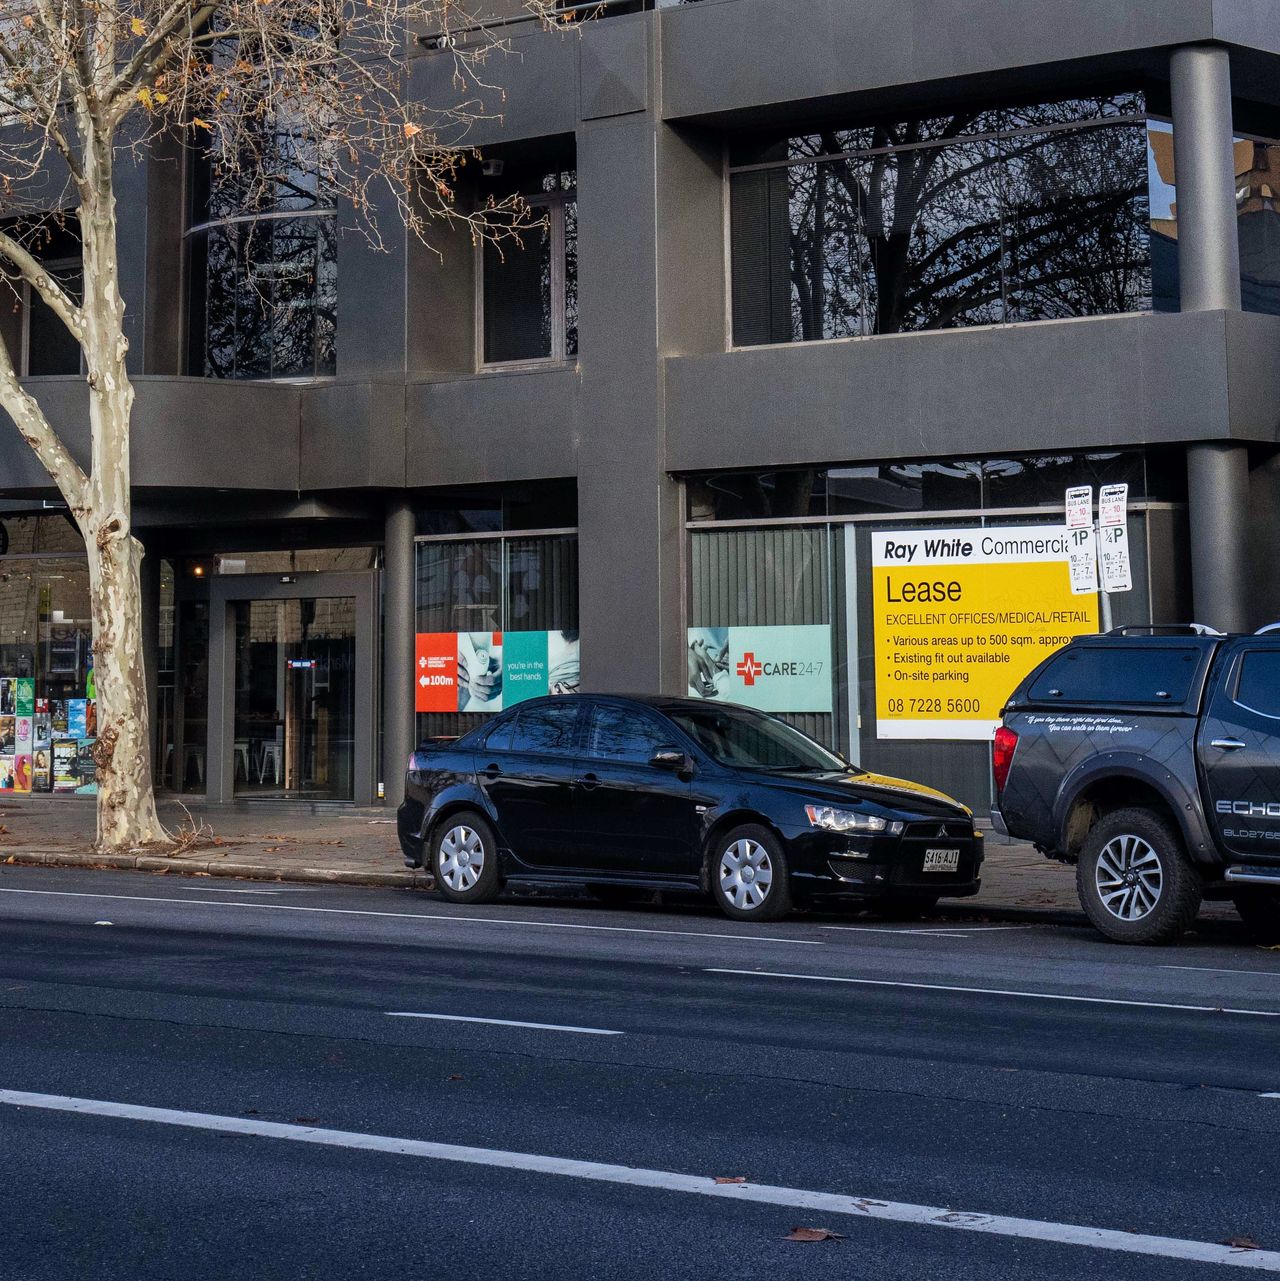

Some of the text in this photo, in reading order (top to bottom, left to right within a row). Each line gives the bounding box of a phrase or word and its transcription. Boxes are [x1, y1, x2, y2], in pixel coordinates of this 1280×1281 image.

[1072, 530, 1088, 546] 1P
[884, 541, 917, 562] Ray
[924, 539, 972, 558] White
[886, 576, 962, 602] Lease
[886, 611, 1091, 626] EXCELLENT OFFICES/MEDICAL/RETAIL
[893, 635, 929, 646] Various
[931, 636, 958, 646] areas
[961, 636, 974, 648] up
[976, 635, 986, 645] to
[989, 634, 1008, 645] 500
[1010, 636, 1035, 648] sqm.
[894, 652, 1010, 665] Existing fit out available
[430, 676, 453, 686] 100m
[523, 672, 541, 680] hands
[894, 670, 969, 682] On-site parking
[888, 698, 980, 712] 08 7228 5600
